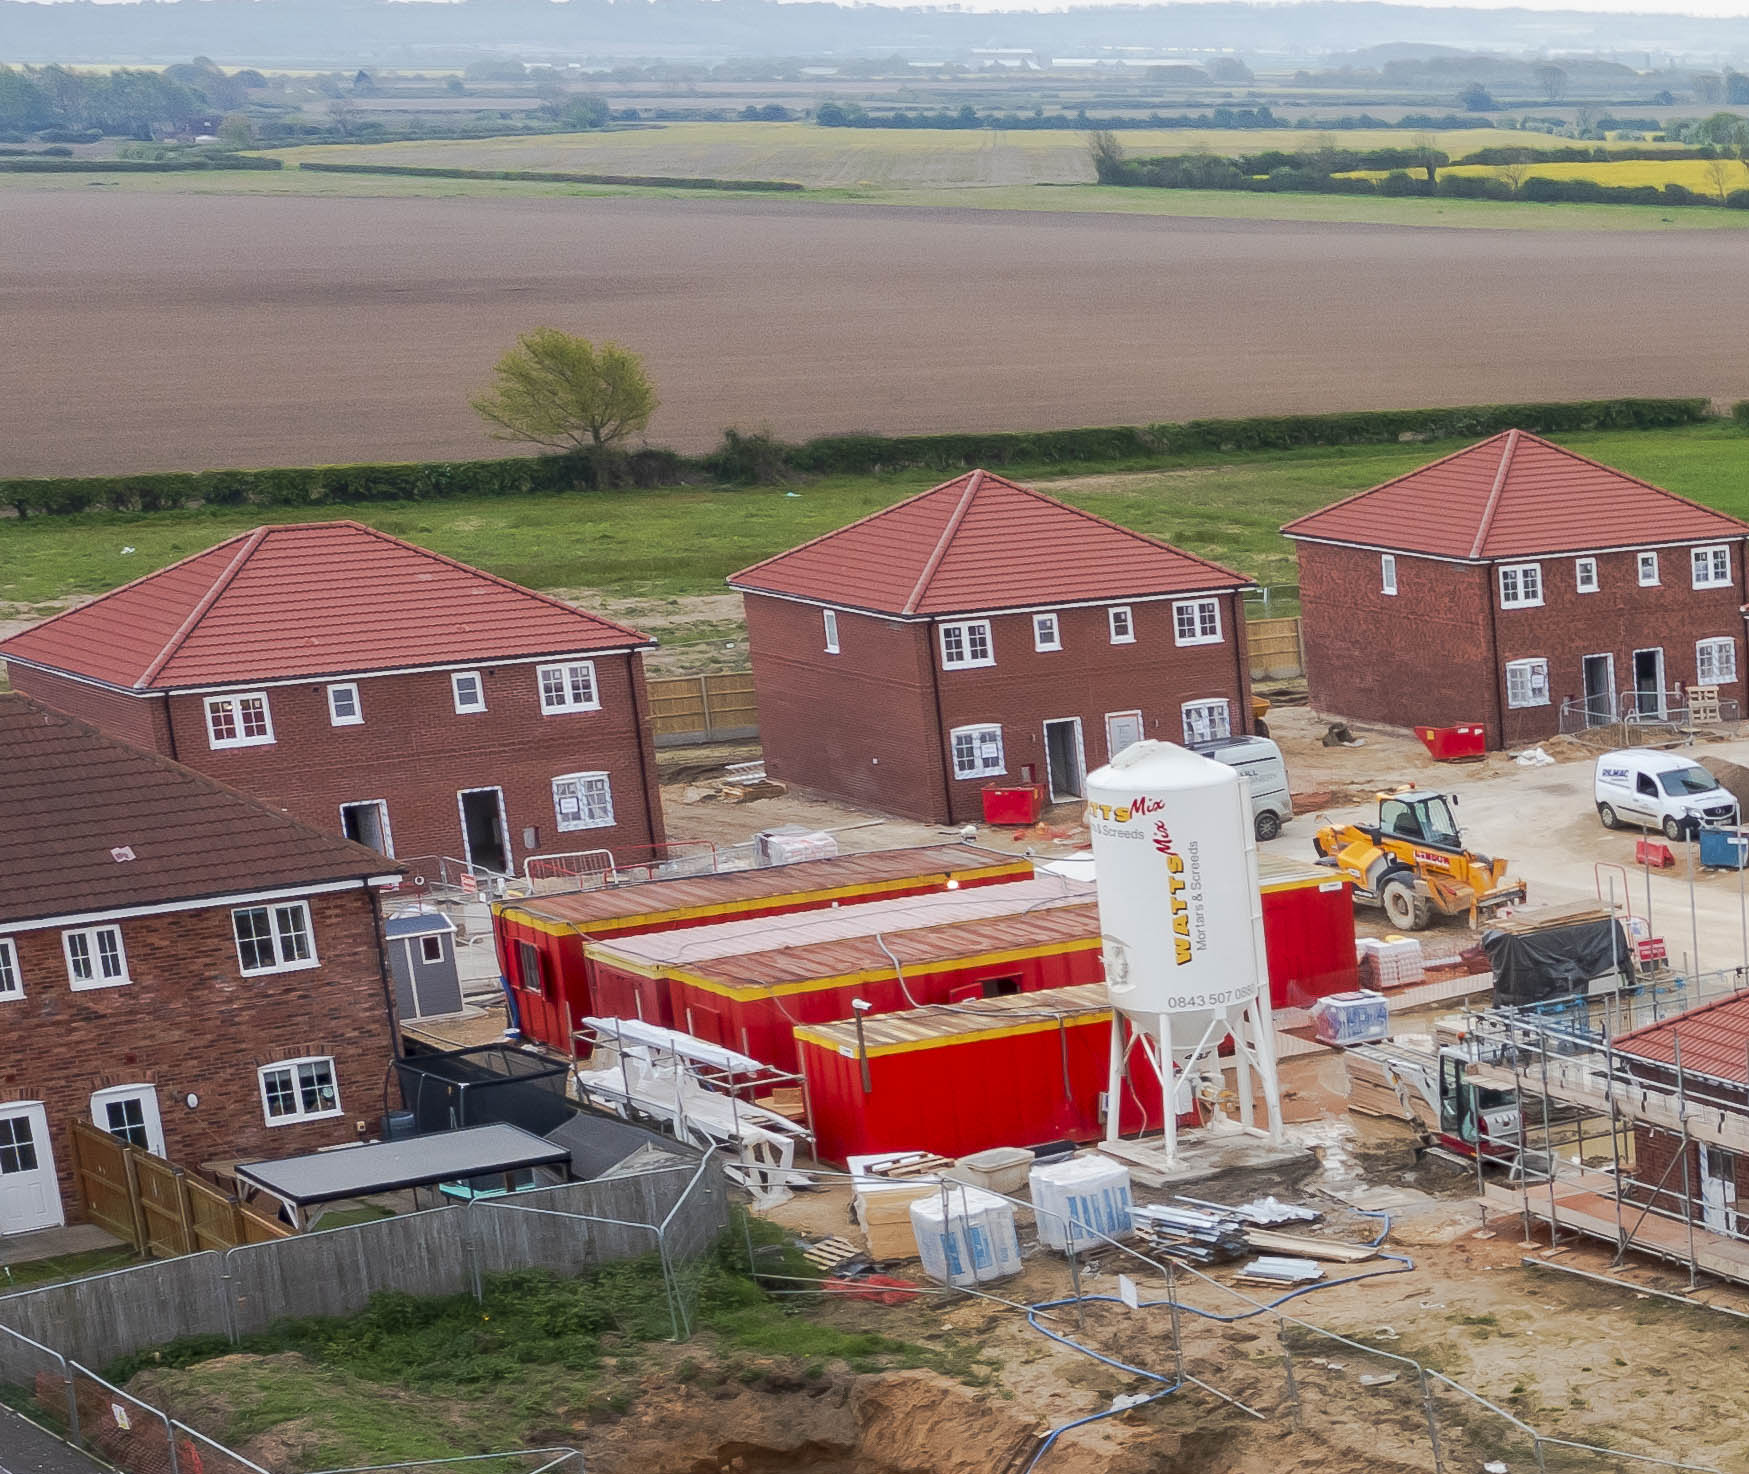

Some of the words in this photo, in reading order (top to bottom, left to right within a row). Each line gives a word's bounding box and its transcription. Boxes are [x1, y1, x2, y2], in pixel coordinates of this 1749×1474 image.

[1130, 797, 1165, 819] Mix
[1103, 824, 1144, 839] Screeds
[1153, 820, 1178, 856] Mix
[1189, 840, 1202, 890] Screeds
[1166, 854, 1192, 966] WATTS
[1192, 893, 1203, 901] &
[1194, 904, 1207, 951] Mortars
[1168, 995, 1206, 1008] 0843
[1209, 991, 1233, 1005] 507
